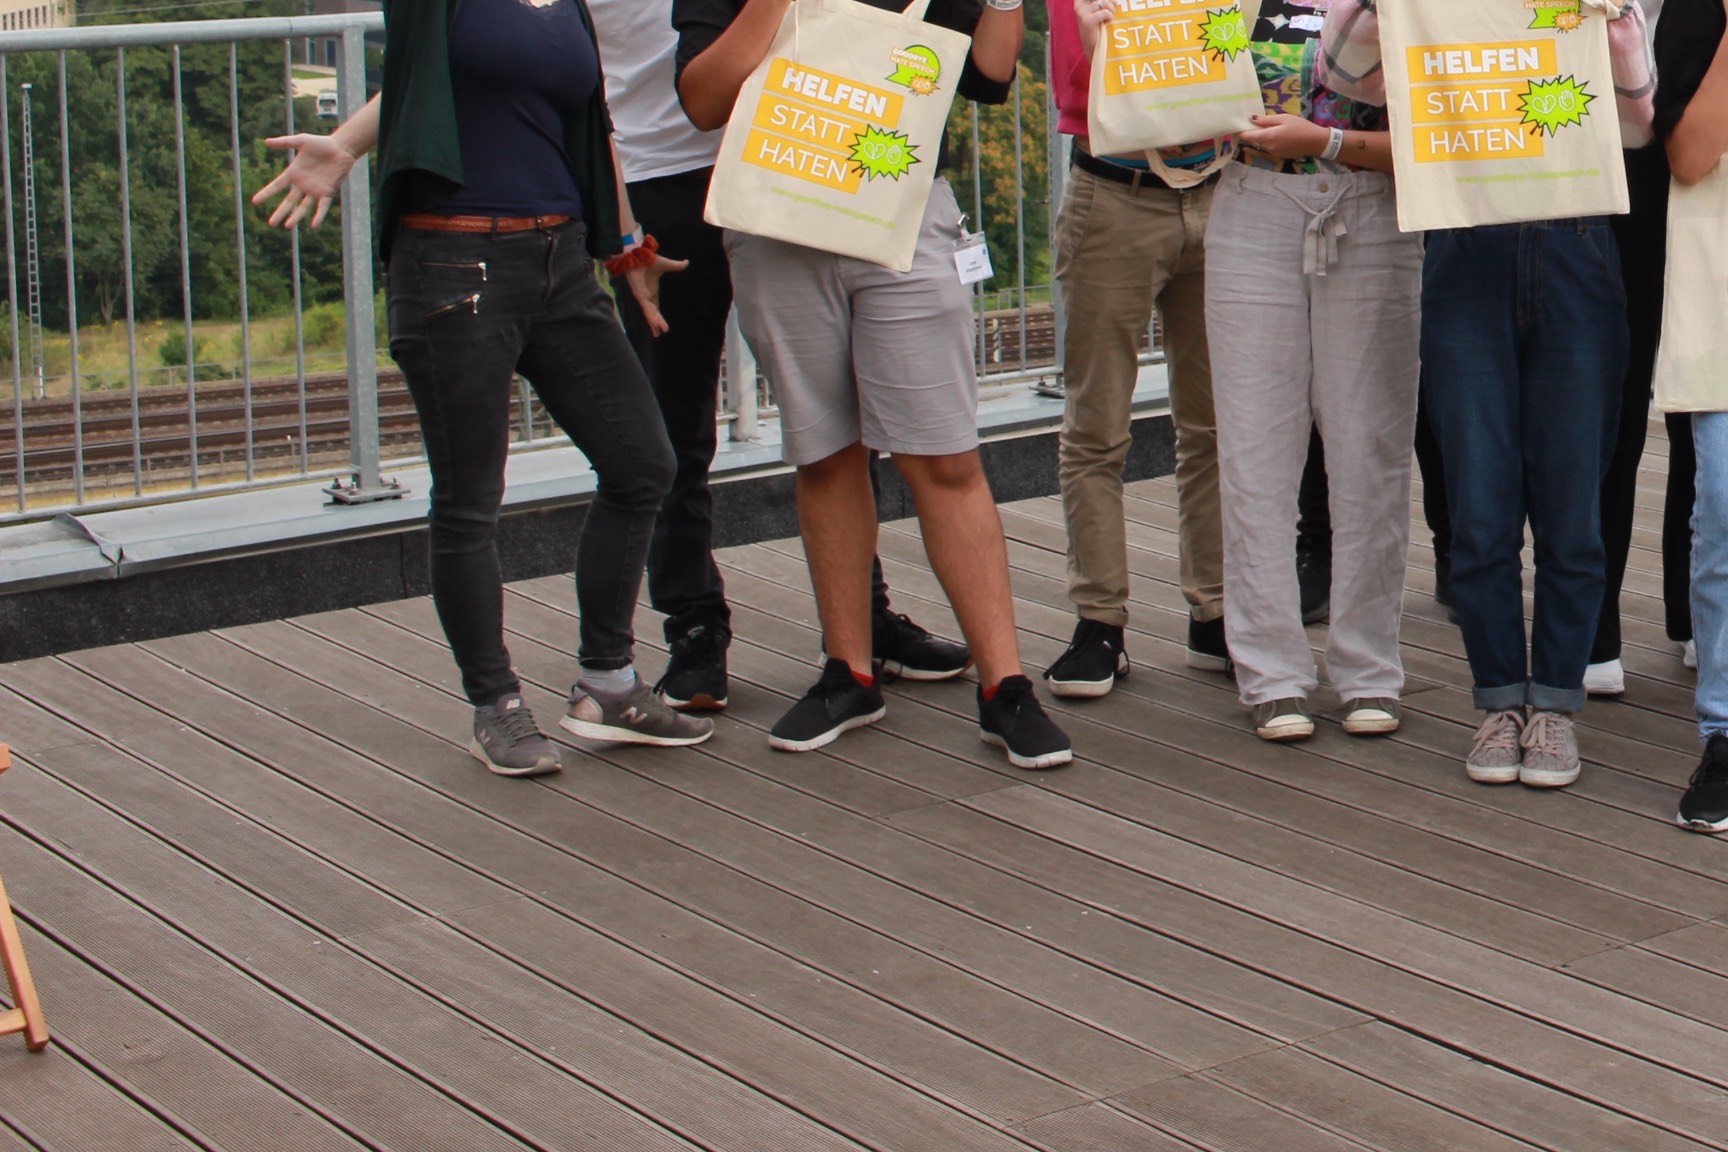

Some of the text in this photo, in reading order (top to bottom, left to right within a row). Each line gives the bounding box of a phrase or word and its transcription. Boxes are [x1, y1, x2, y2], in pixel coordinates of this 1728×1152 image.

[1525, 0, 1575, 9] HATE SPEECH
[1113, 19, 1192, 49] STATT
[892, 48, 928, 64] GOODBYE
[1119, 54, 1208, 86] HATEN
[1423, 47, 1539, 75] HELFEN
[781, 67, 887, 118] HELFEN
[1427, 88, 1511, 115] STATT
[770, 104, 852, 144] STATT
[1430, 127, 1525, 154] HATEN
[758, 139, 848, 183] HATEN
